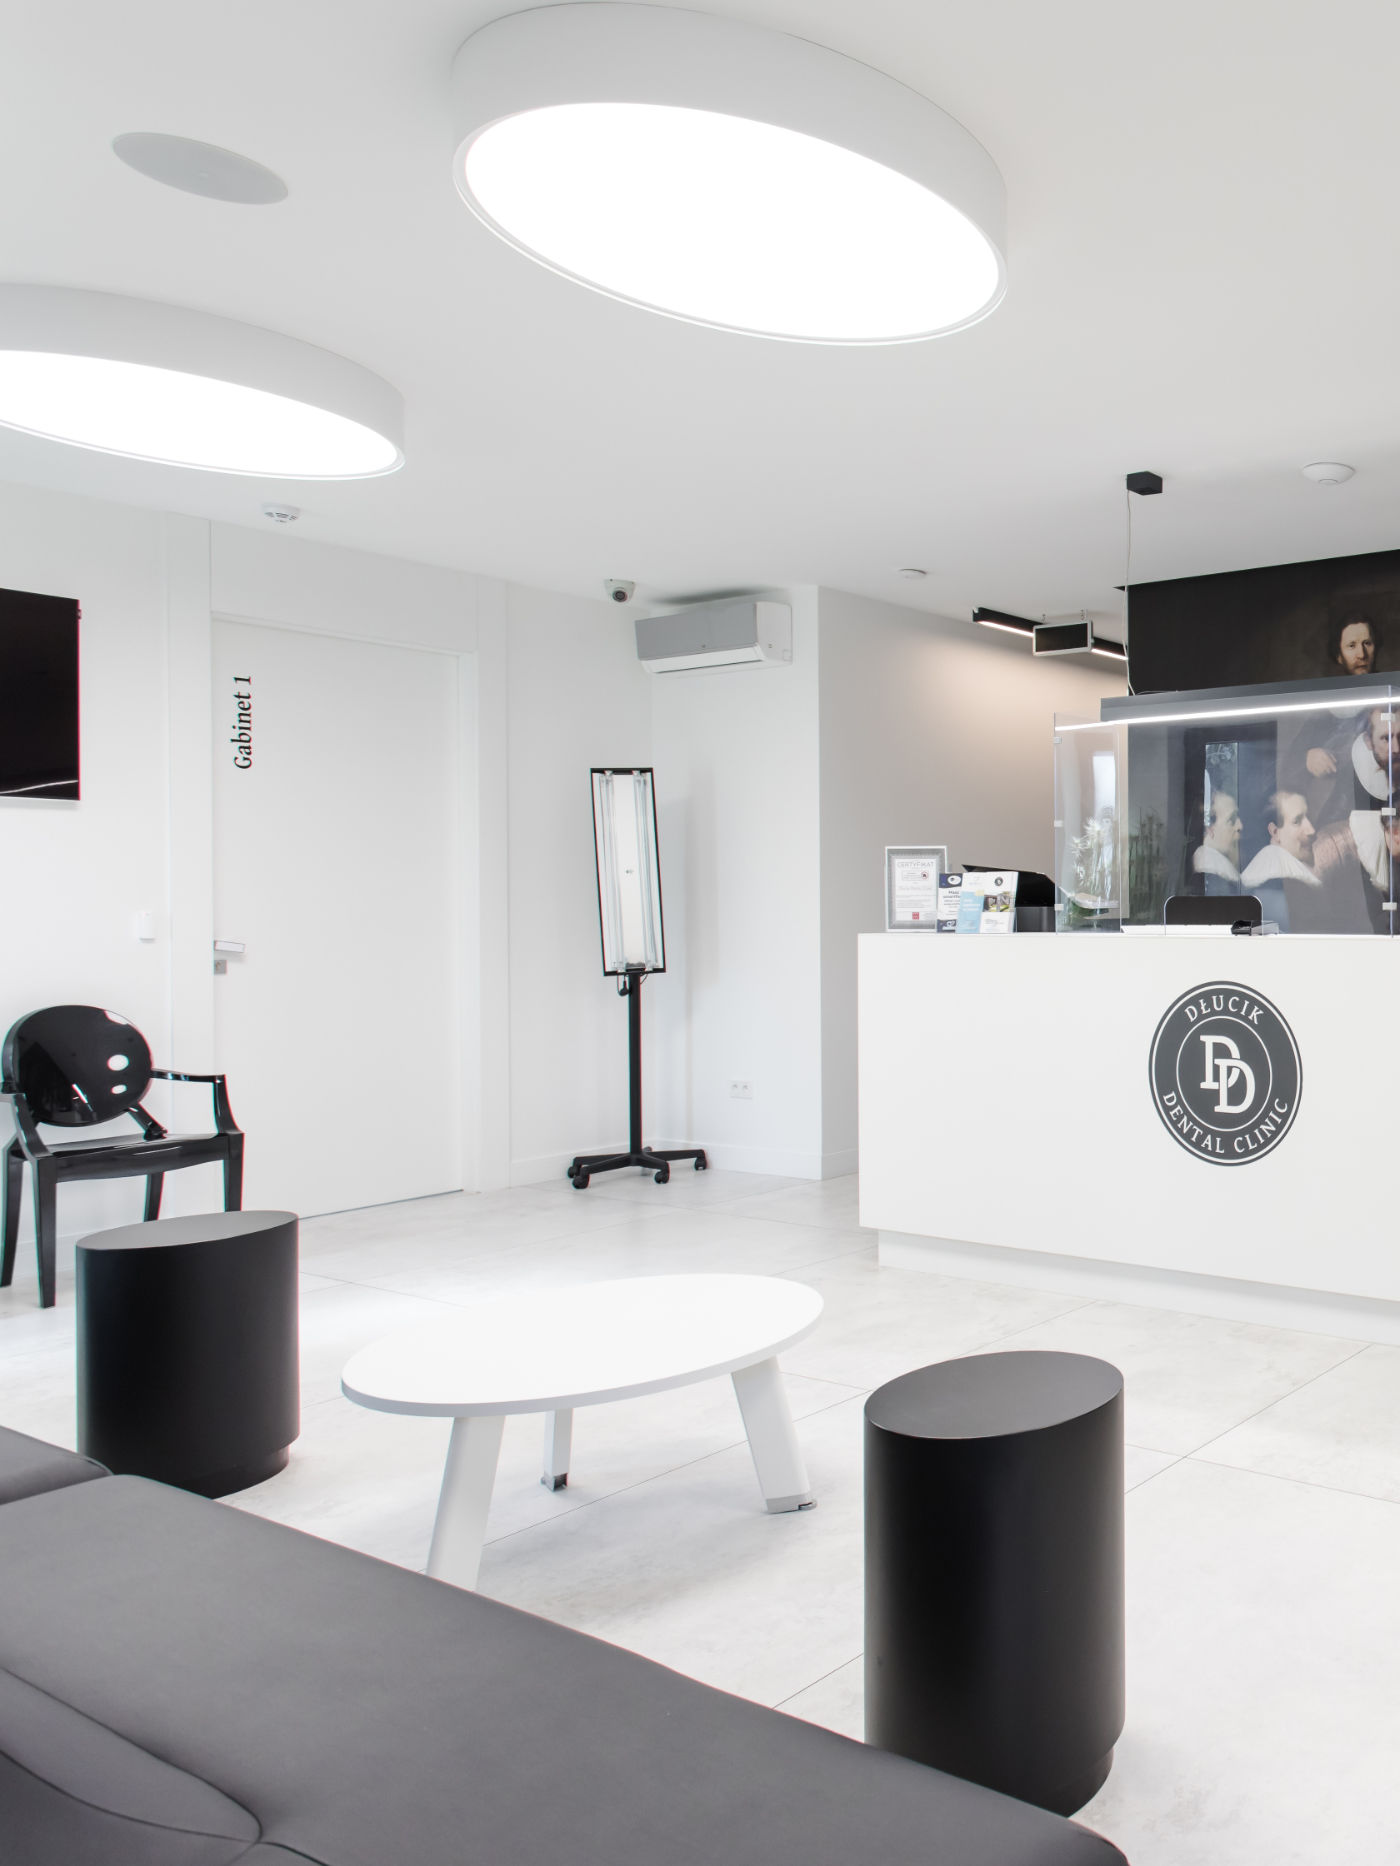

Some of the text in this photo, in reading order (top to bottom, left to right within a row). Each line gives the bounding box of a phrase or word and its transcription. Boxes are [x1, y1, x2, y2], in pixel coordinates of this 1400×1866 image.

[230, 676, 252, 769] Gabinet 1
[1184, 995, 1264, 1025] DŁUCIK
[1163, 1091, 1288, 1153] DENTAL CLINIC
